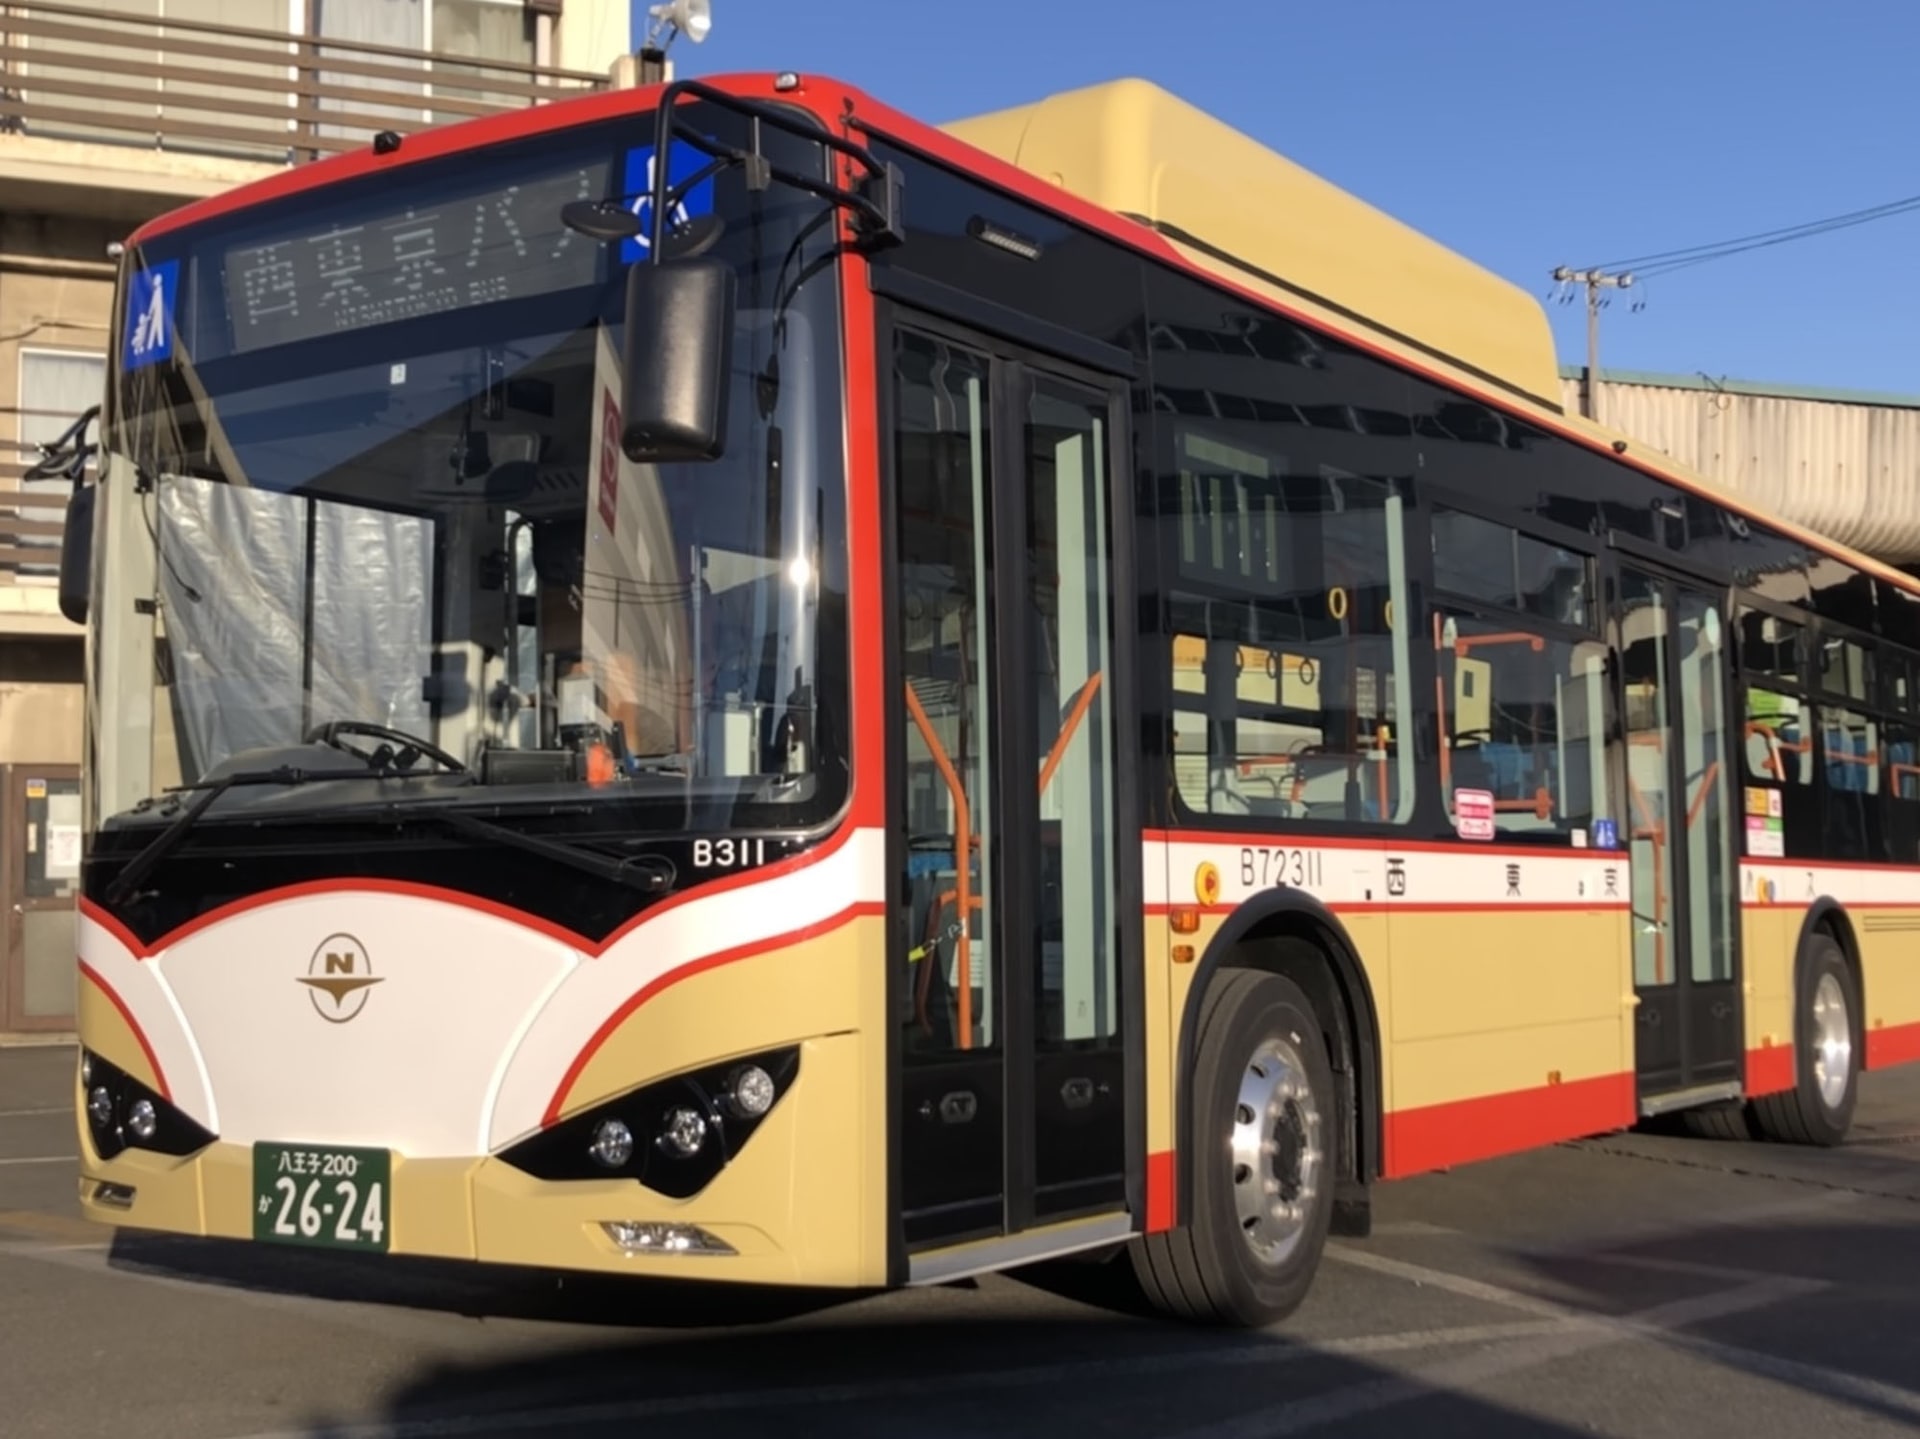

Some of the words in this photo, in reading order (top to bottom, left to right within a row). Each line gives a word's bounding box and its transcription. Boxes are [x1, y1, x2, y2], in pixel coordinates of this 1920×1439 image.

[694, 838, 764, 867] B311
[1241, 848, 1322, 888] B72311
[326, 952, 354, 974] N
